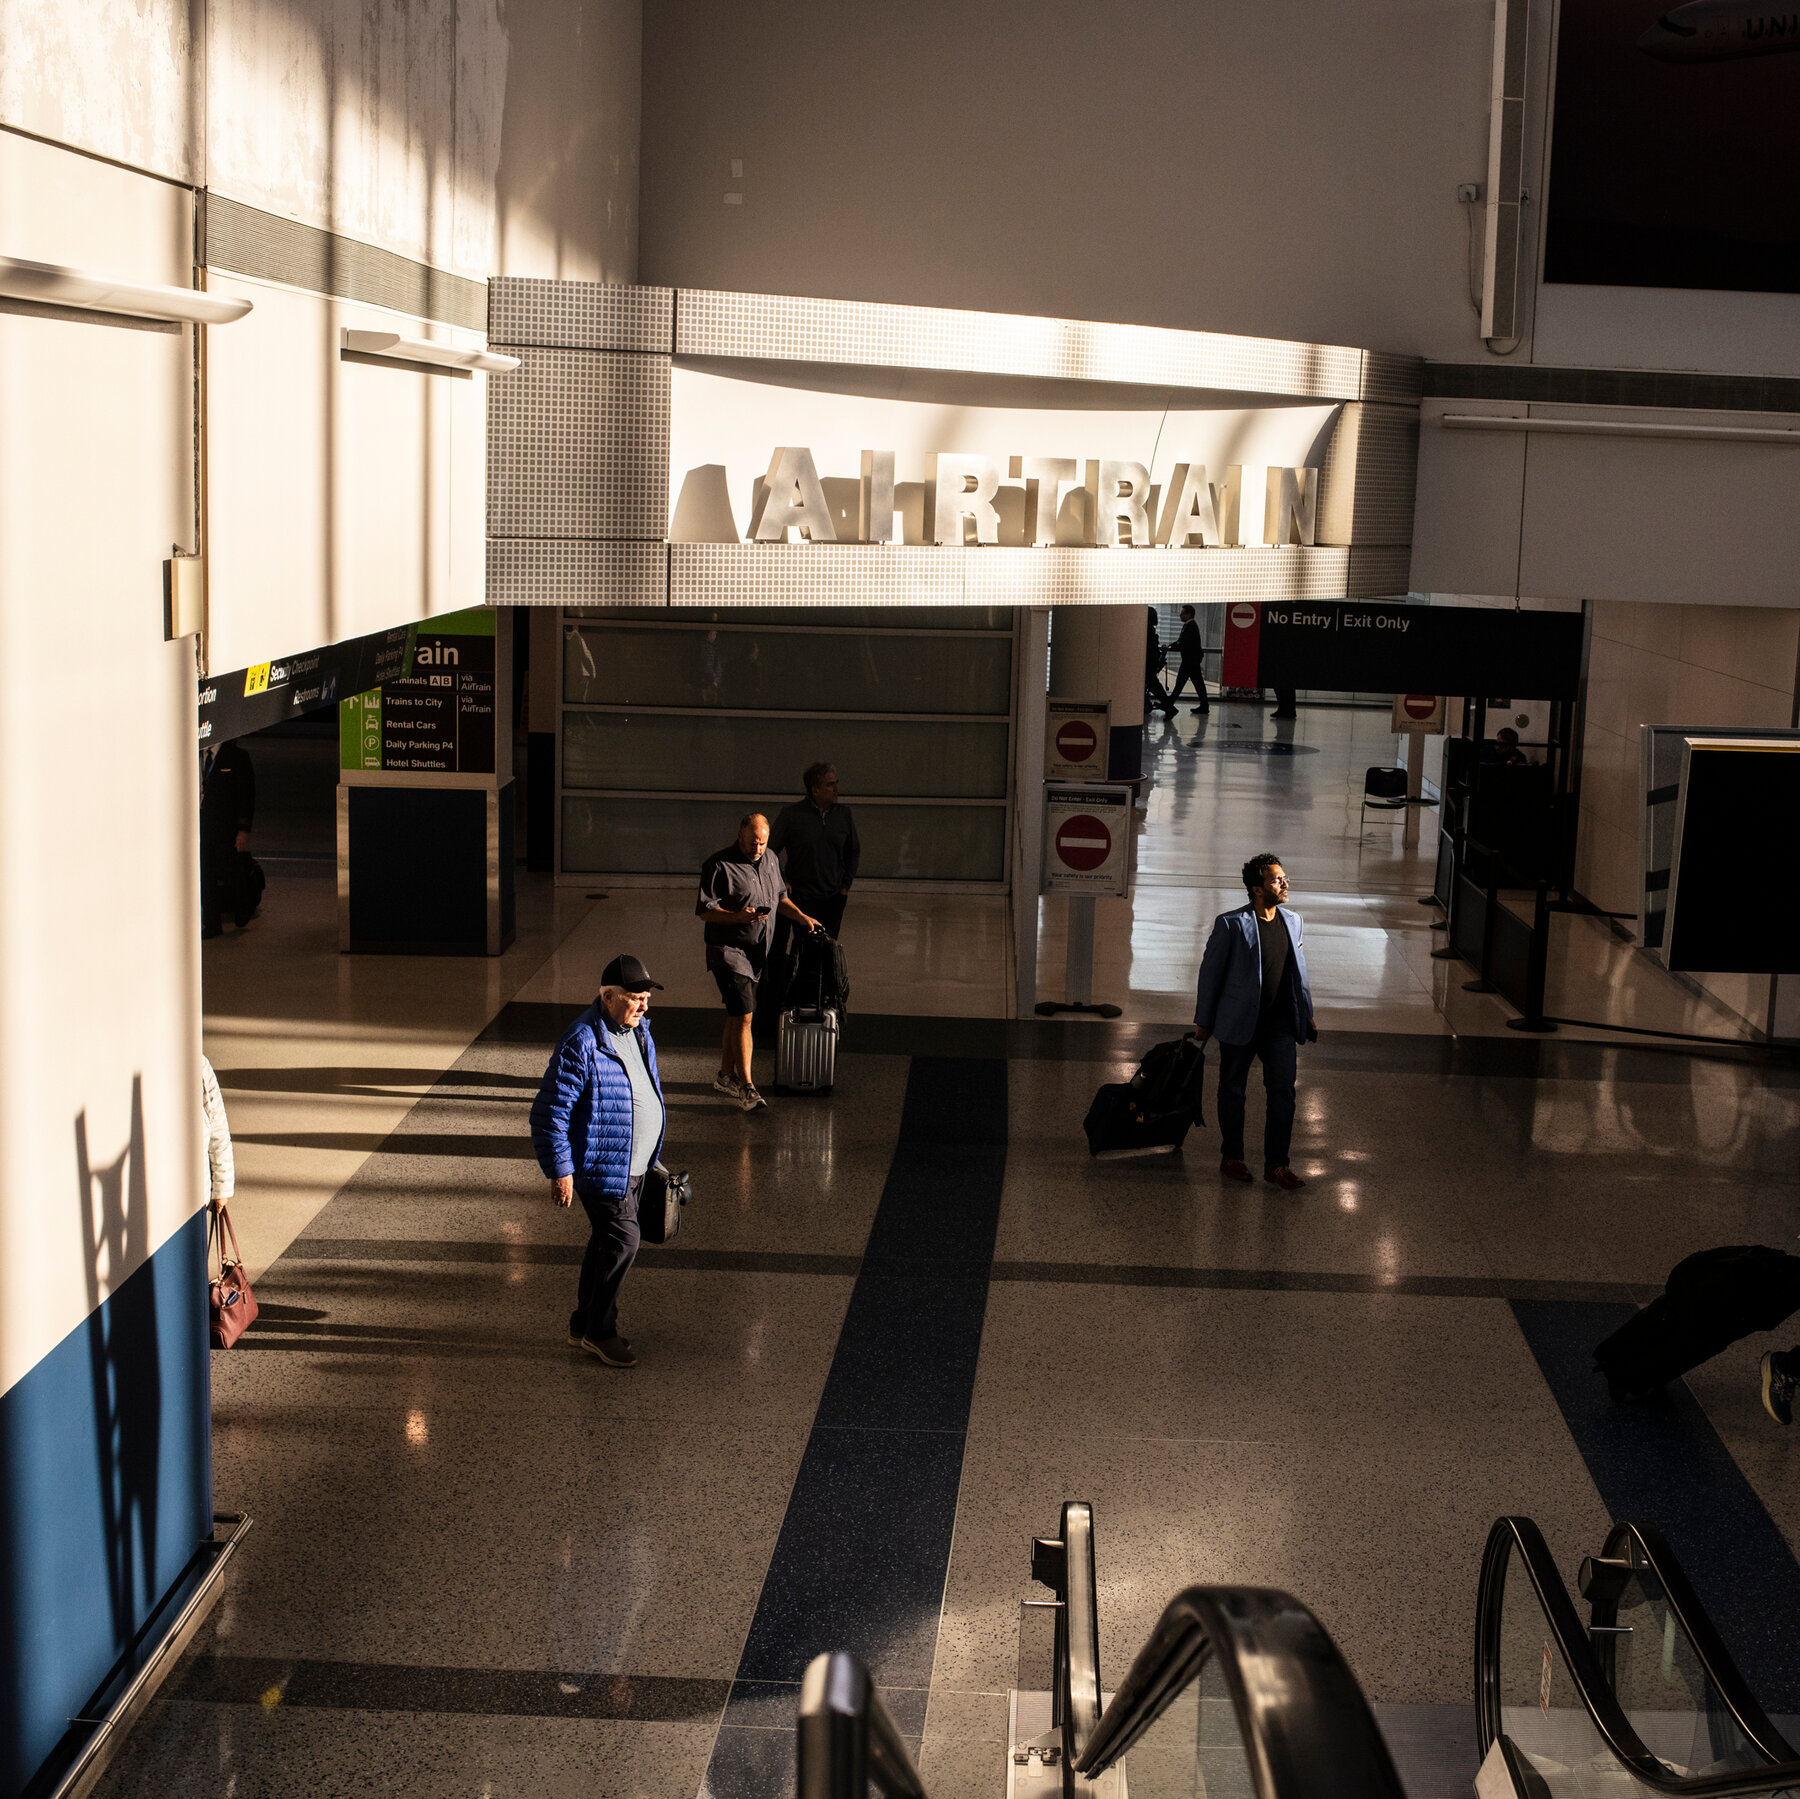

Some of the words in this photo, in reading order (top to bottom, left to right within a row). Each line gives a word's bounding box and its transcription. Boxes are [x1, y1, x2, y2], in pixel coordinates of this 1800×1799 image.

[748, 447, 1318, 547] AIRTRAIN
[1267, 611, 1289, 625] No
[1292, 612, 1332, 629] Entry
[1343, 614, 1373, 629] Exit
[1375, 615, 1411, 633] Only
[414, 640, 459, 665] ain
[461, 674, 473, 682] via
[461, 683, 491, 692] AirTrain
[386, 697, 413, 706] Trains
[415, 698, 423, 706] to
[425, 698, 443, 709] City
[461, 696, 473, 704] via
[461, 705, 491, 713] AirTrain
[386, 720, 414, 729] Rental
[416, 721, 437, 730] Cars
[386, 740, 407, 750] Daily
[409, 740, 440, 752] Parking
[442, 741, 454, 750] P4
[386, 759, 409, 768] Hotel
[411, 759, 446, 769] Shuttles
